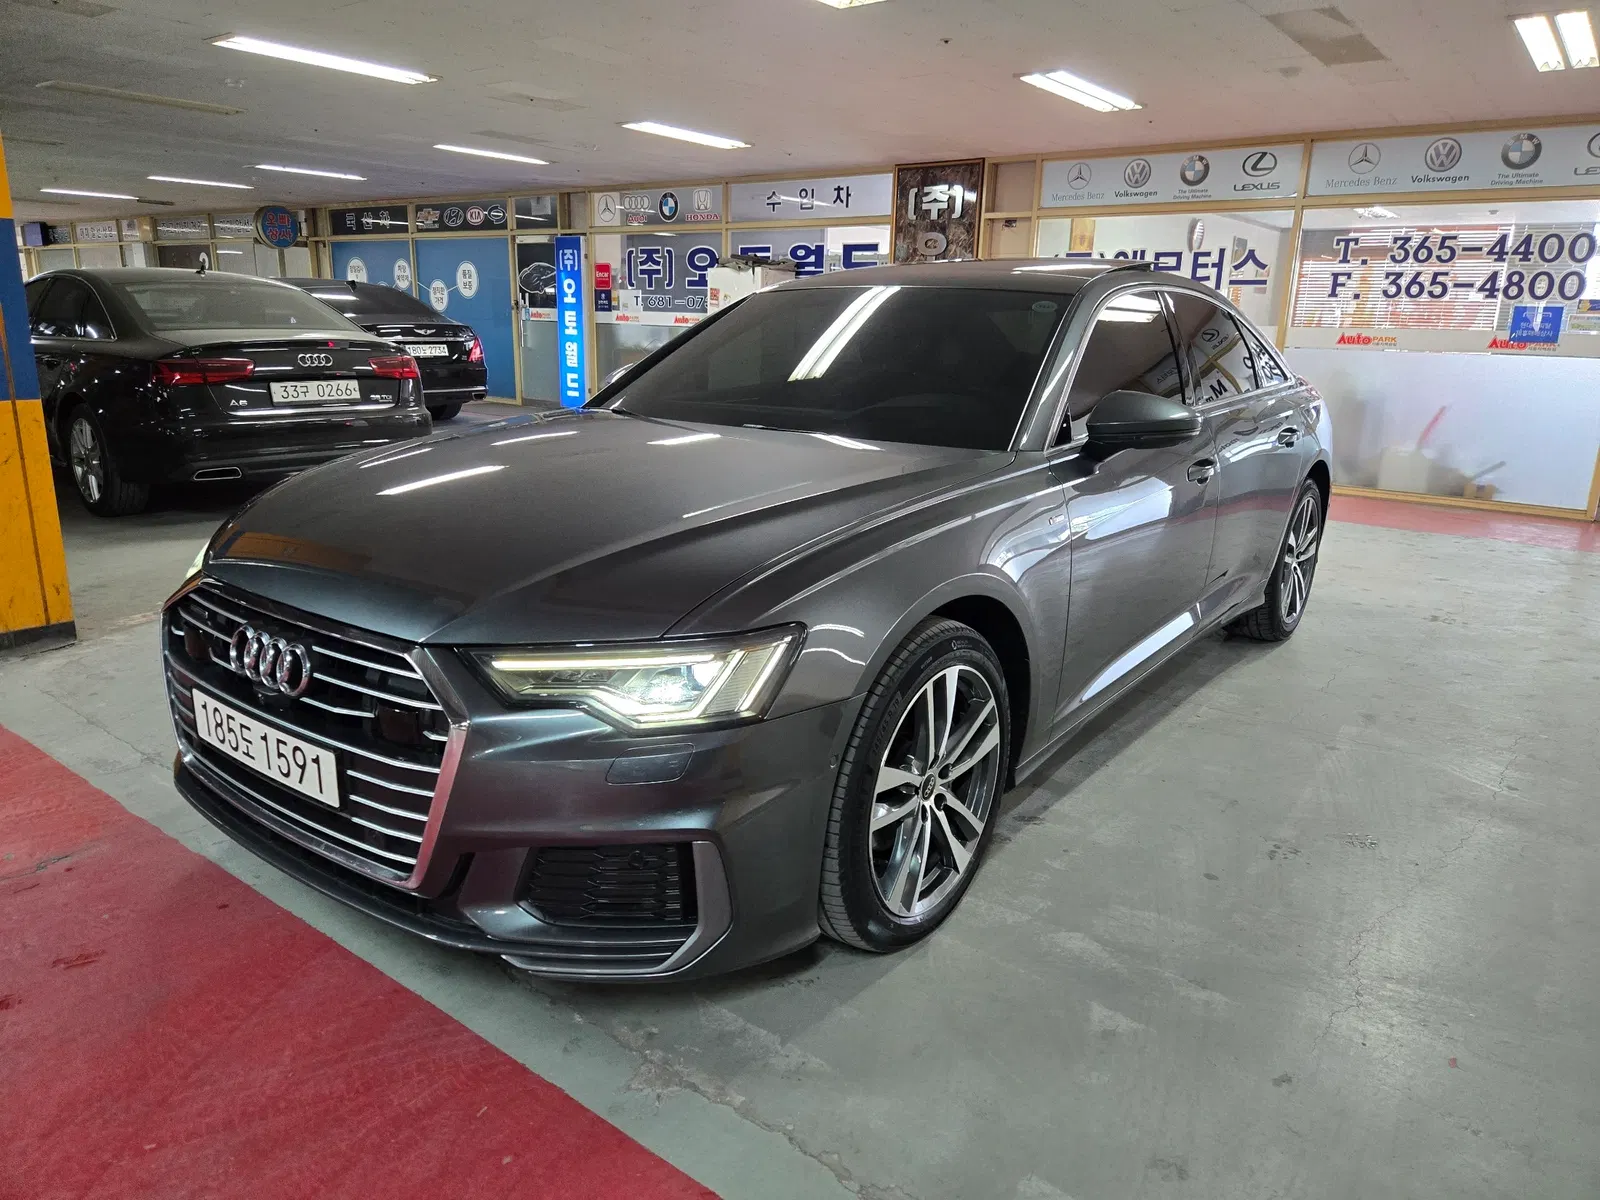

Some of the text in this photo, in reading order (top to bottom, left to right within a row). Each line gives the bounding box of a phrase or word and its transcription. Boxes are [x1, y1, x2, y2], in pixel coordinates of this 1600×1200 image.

[1325, 176, 1398, 189] Mercedes Benz
[1411, 174, 1470, 184] Volkswagen
[1234, 182, 1281, 192] LEXUS
[1052, 191, 1105, 202] Mercedes Benz
[1114, 189, 1158, 199] Volkswagen
[267, 213, 291, 228] 오빠
[469, 210, 483, 223] KIA
[627, 213, 648, 223] Audi
[685, 213, 720, 221] HONDA
[268, 229, 292, 242] 상사
[1333, 232, 1598, 266] T. 365-4400
[1327, 270, 1587, 301] F. 365-4800
[673, 315, 690, 324] Auto
[1335, 332, 1373, 346] Auto
[280, 383, 353, 400] 33구 0266
[201, 700, 324, 795] 185도 1591
